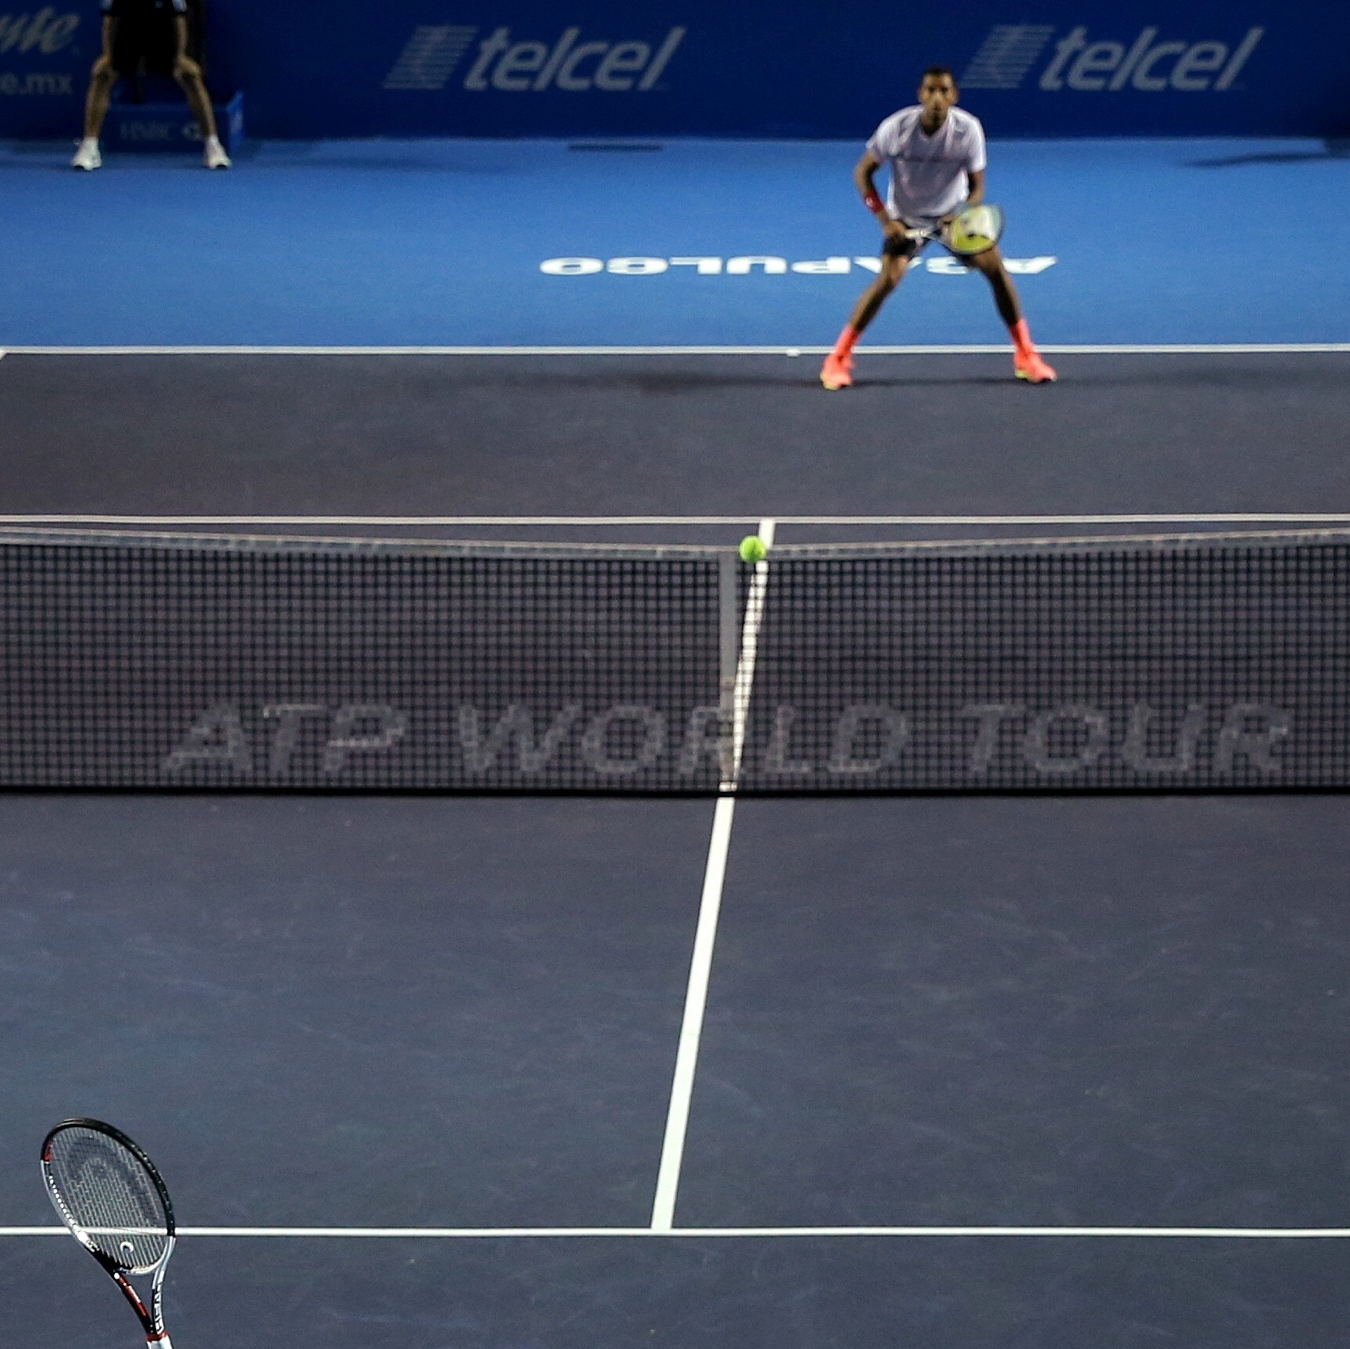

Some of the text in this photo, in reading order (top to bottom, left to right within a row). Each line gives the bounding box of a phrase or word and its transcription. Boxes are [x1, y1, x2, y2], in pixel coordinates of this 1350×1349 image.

[463, 26, 686, 91] telcel
[1037, 26, 1264, 91] telcel
[161, 702, 1295, 774] ATP WORLD TOUR
